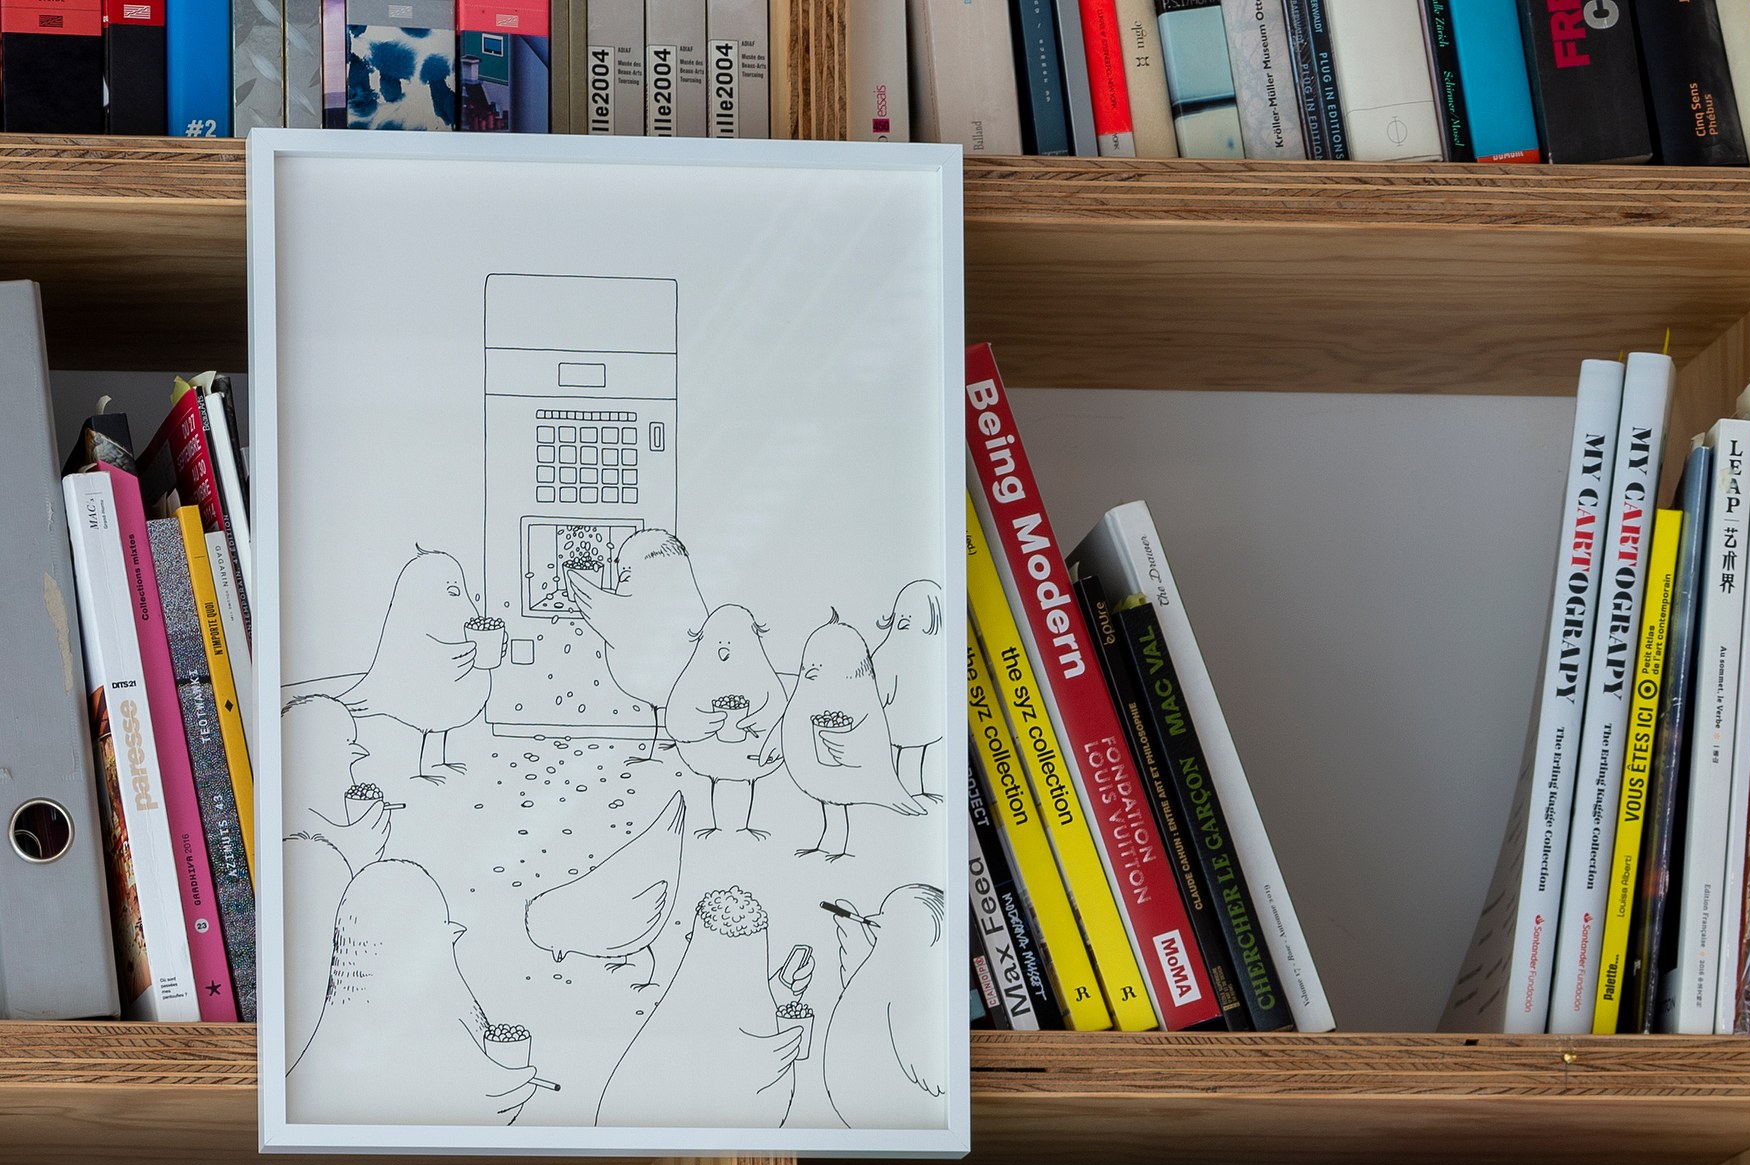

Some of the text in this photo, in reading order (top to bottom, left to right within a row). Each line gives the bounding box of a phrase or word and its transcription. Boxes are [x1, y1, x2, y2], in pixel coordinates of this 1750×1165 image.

[876, 84, 887, 117] essais
[1262, 24, 1284, 148] Kröller-Müller Museum
[1319, 52, 1331, 84] PLUG
[974, 120, 984, 151] Balland
[1689, 82, 1707, 138] Cinq Sens
[214, 545, 229, 588] GAGARIN
[966, 378, 1086, 681] Being Modern
[1556, 432, 1606, 704] MY CARTOGRAPY
[1602, 426, 1653, 701] MY CARTOGRAPY
[1718, 527, 1738, 593] 艺术界
[129, 533, 150, 621] Collections mixtes
[1153, 678, 1187, 738] MAC
[120, 699, 159, 812] paresse
[1027, 724, 1074, 827] collection
[1624, 706, 1654, 823] VOUS ÊTES ICI
[1084, 741, 1152, 906] LOUIS VUITTON
[1101, 735, 1157, 864] FONDATION
[1538, 726, 1566, 893] The Collection
[182, 833, 192, 855] 2016
[1180, 757, 1275, 1010] CHERCHER GARÇON
[1621, 855, 1633, 889] Alberti
[995, 940, 1033, 1017] Max
[1159, 937, 1191, 999] MoMA
[1531, 926, 1543, 974] Santander
